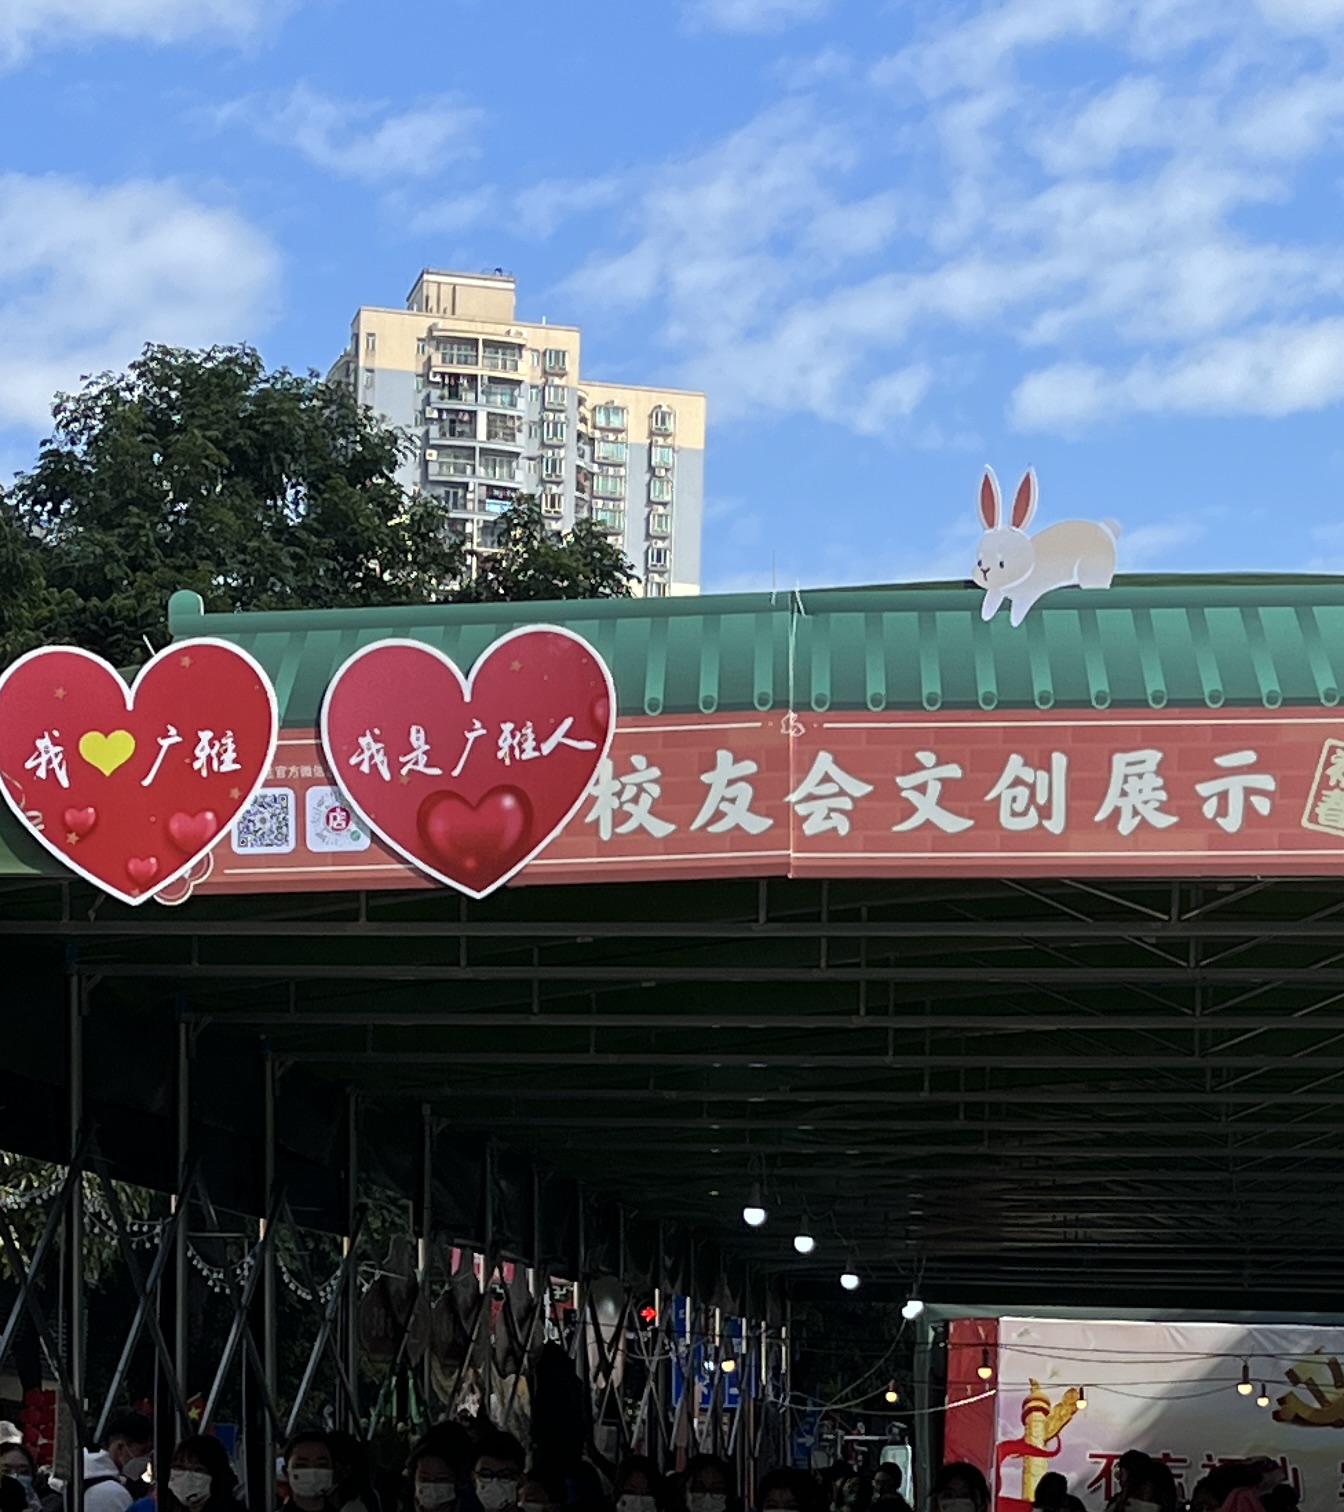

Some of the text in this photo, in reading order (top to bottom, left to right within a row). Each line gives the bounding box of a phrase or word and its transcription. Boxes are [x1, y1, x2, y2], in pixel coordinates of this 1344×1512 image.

[24, 723, 242, 789] 我 广雅
[349, 715, 597, 782] 我是广雅人
[585, 749, 1277, 841] 校友会文创展示
